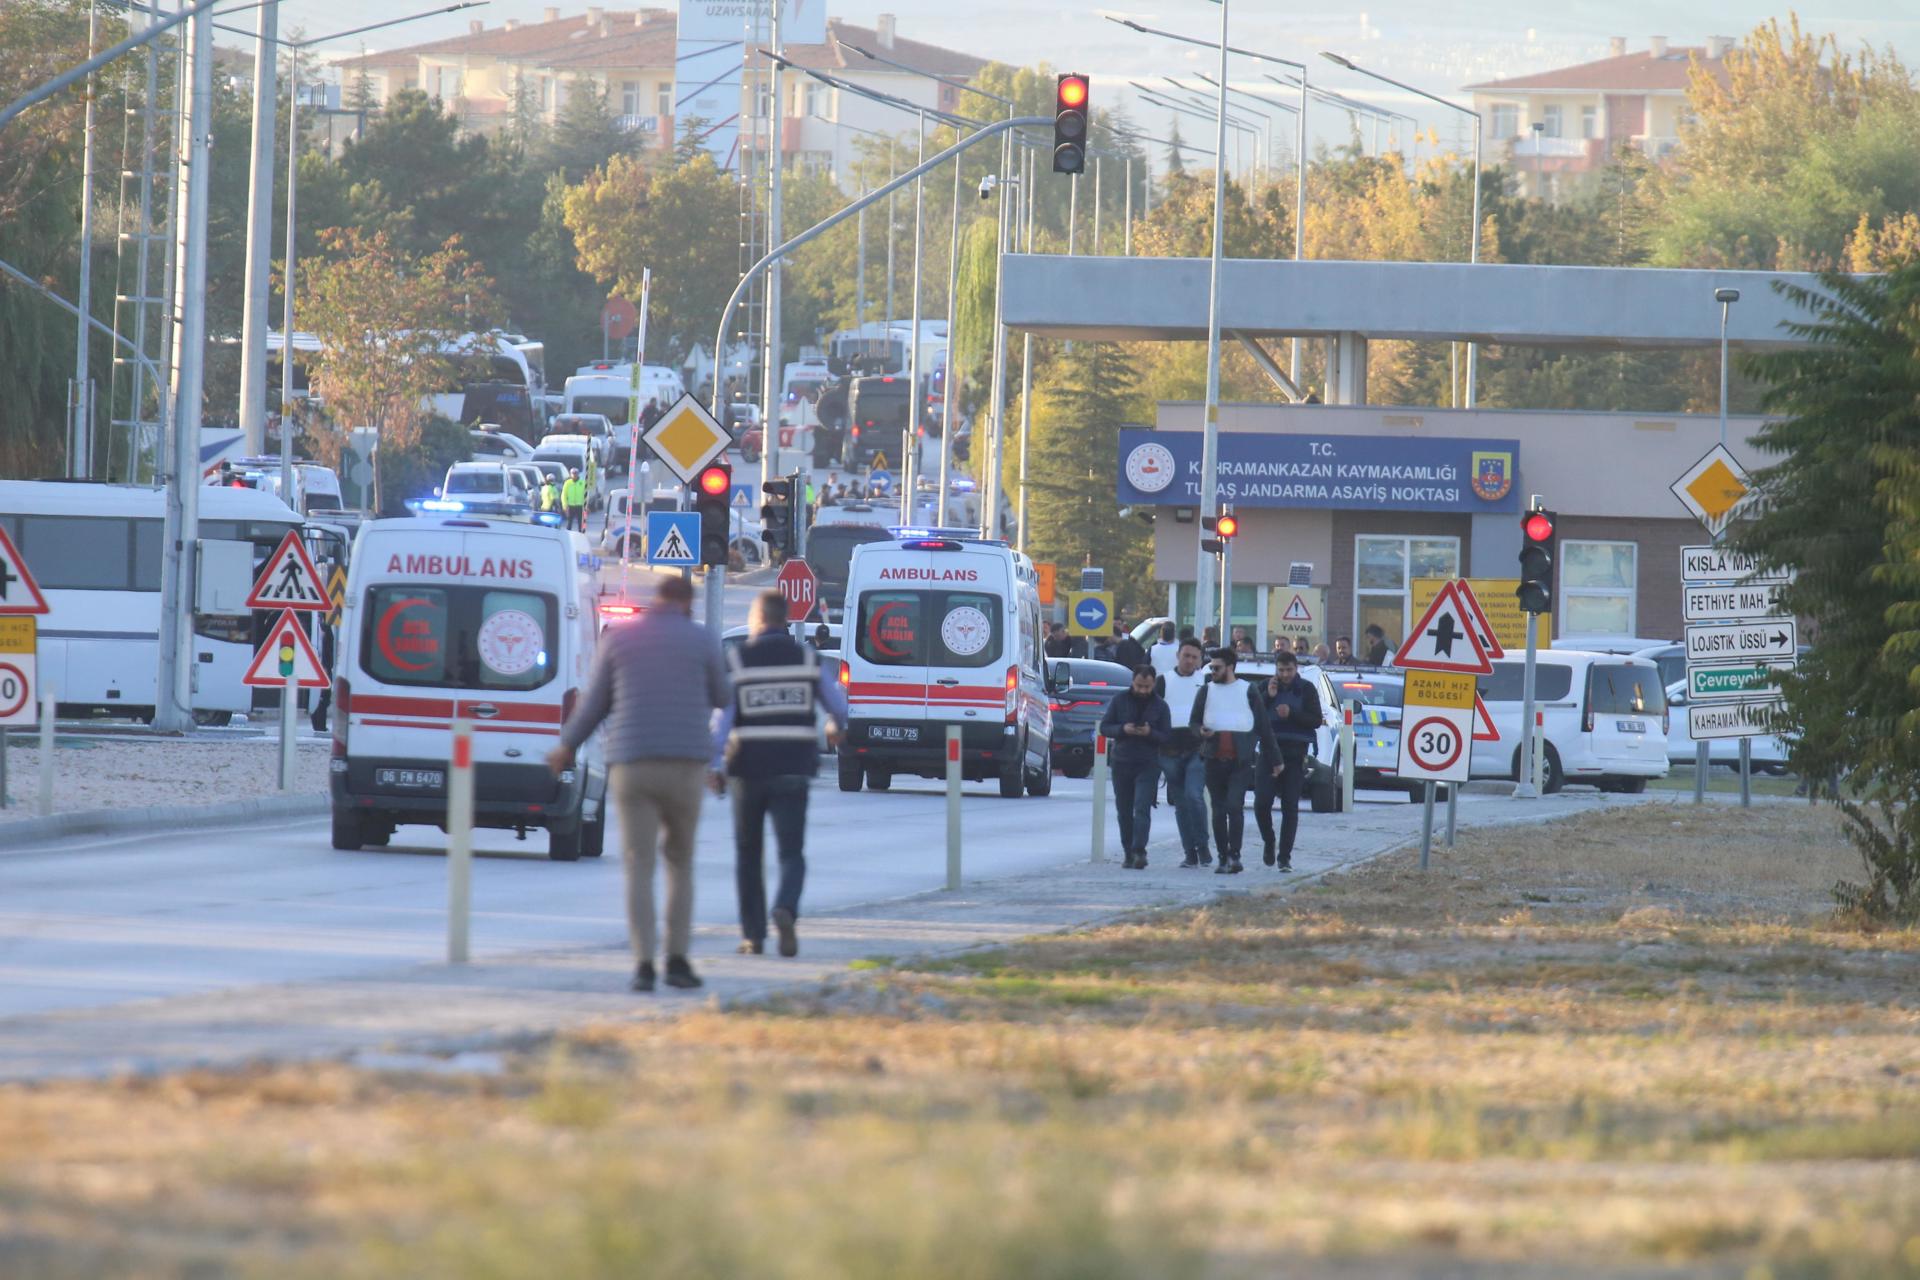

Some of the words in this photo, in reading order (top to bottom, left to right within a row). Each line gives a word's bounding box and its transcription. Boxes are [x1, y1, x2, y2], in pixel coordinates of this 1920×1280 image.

[1310, 443, 1336, 456] T.C.
[1189, 461, 1332, 477] KHRAMANKAZAN
[1337, 464, 1456, 480] KAYMAKAMLIĞI
[1185, 482, 1236, 499] TUAŞ
[1241, 483, 1328, 498] JANDARMA
[1331, 484, 1387, 503] ASAYİŞ
[1392, 487, 1459, 502] NOKTASI
[387, 554, 534, 579] AMBULANS
[880, 568, 979, 582] AMBULANS
[1688, 556, 1726, 575] KIŞLA
[780, 579, 812, 603] DUR
[1740, 594, 1766, 609] MAH.
[1282, 624, 1313, 634] YAVAŞ
[1740, 629, 1767, 649] ÜSSÜ
[1413, 679, 1446, 689] AZAMİ
[1452, 683, 1470, 691] HIZ
[1695, 713, 1739, 730] KAHRAMAN
[1420, 732, 1450, 755] 30
